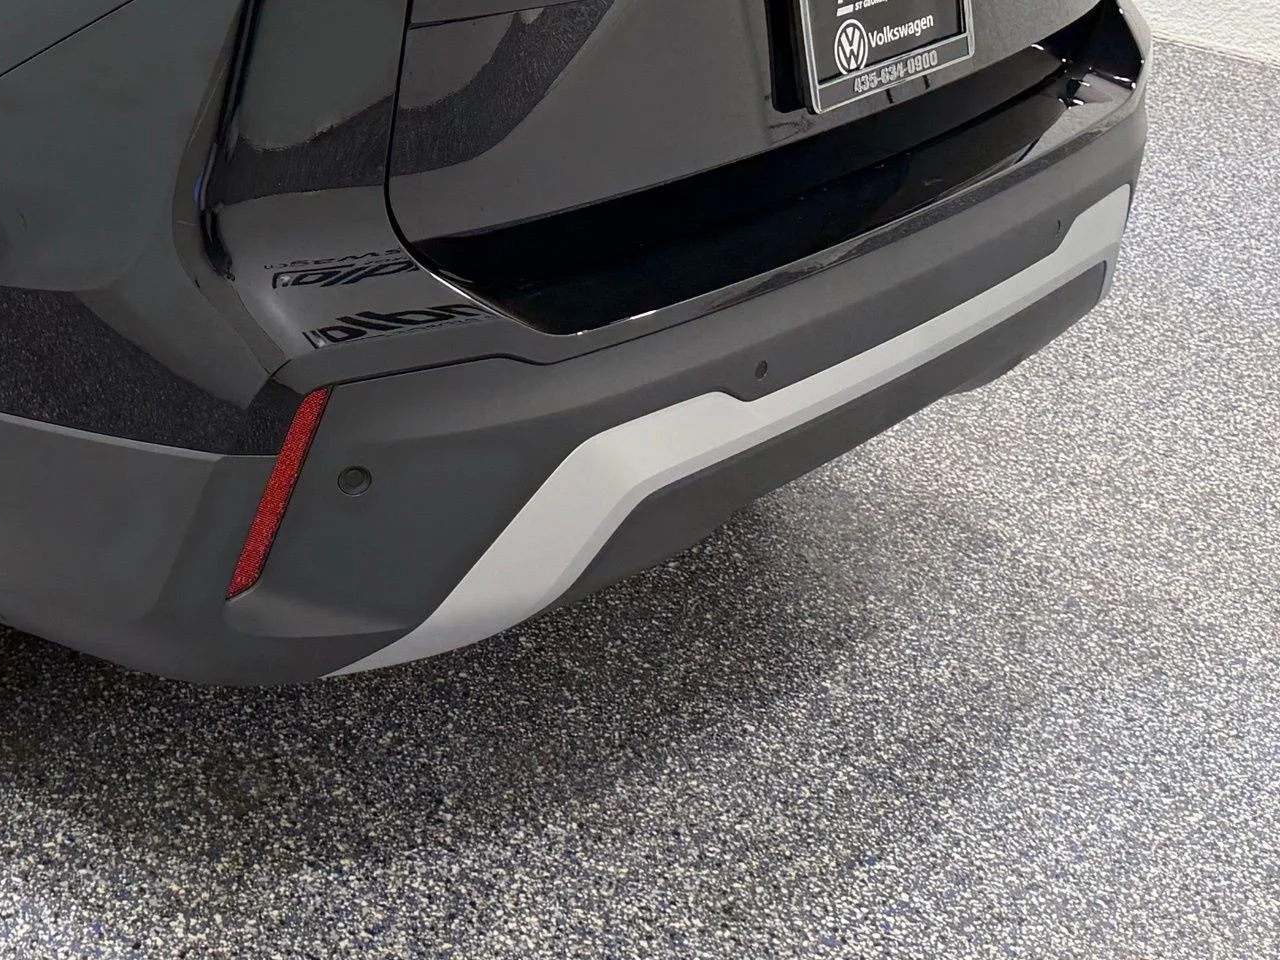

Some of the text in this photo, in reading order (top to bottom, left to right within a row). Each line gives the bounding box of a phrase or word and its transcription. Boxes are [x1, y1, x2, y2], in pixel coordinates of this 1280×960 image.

[854, 0, 863, 11] ST
[868, 14, 934, 48] Volkswagen
[854, 49, 938, 93] 435-634-0900
